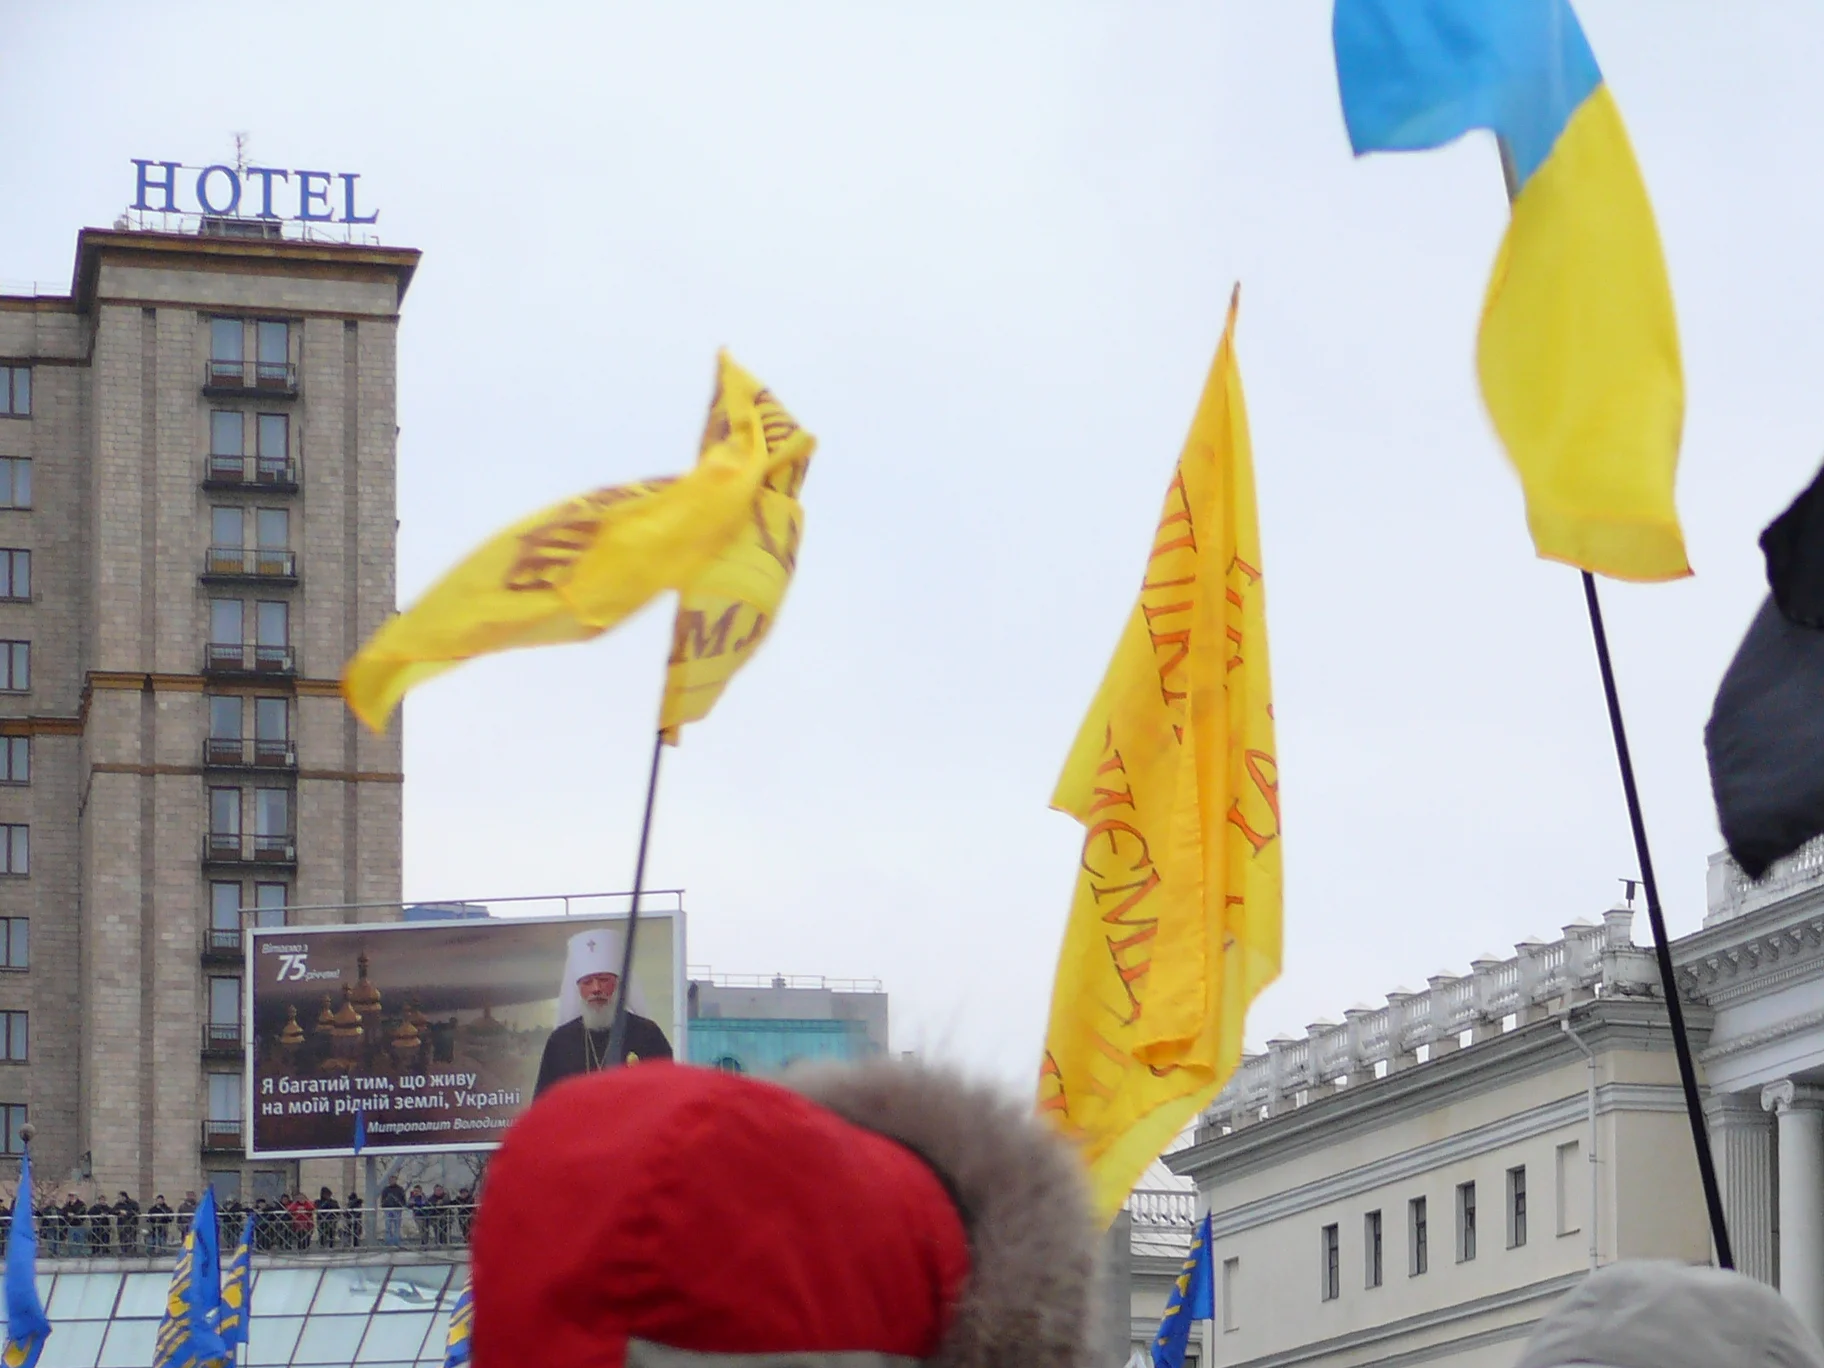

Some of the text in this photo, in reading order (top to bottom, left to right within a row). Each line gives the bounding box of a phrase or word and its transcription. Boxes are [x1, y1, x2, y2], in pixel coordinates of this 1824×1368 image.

[130, 158, 380, 224] HOTEL
[277, 954, 308, 981] 75
[261, 1073, 477, 1095] Я багатий тим, що живу
[262, 1089, 521, 1116] на моїй рідній землі, Україні
[367, 1116, 517, 1134] Митрополит Володими
